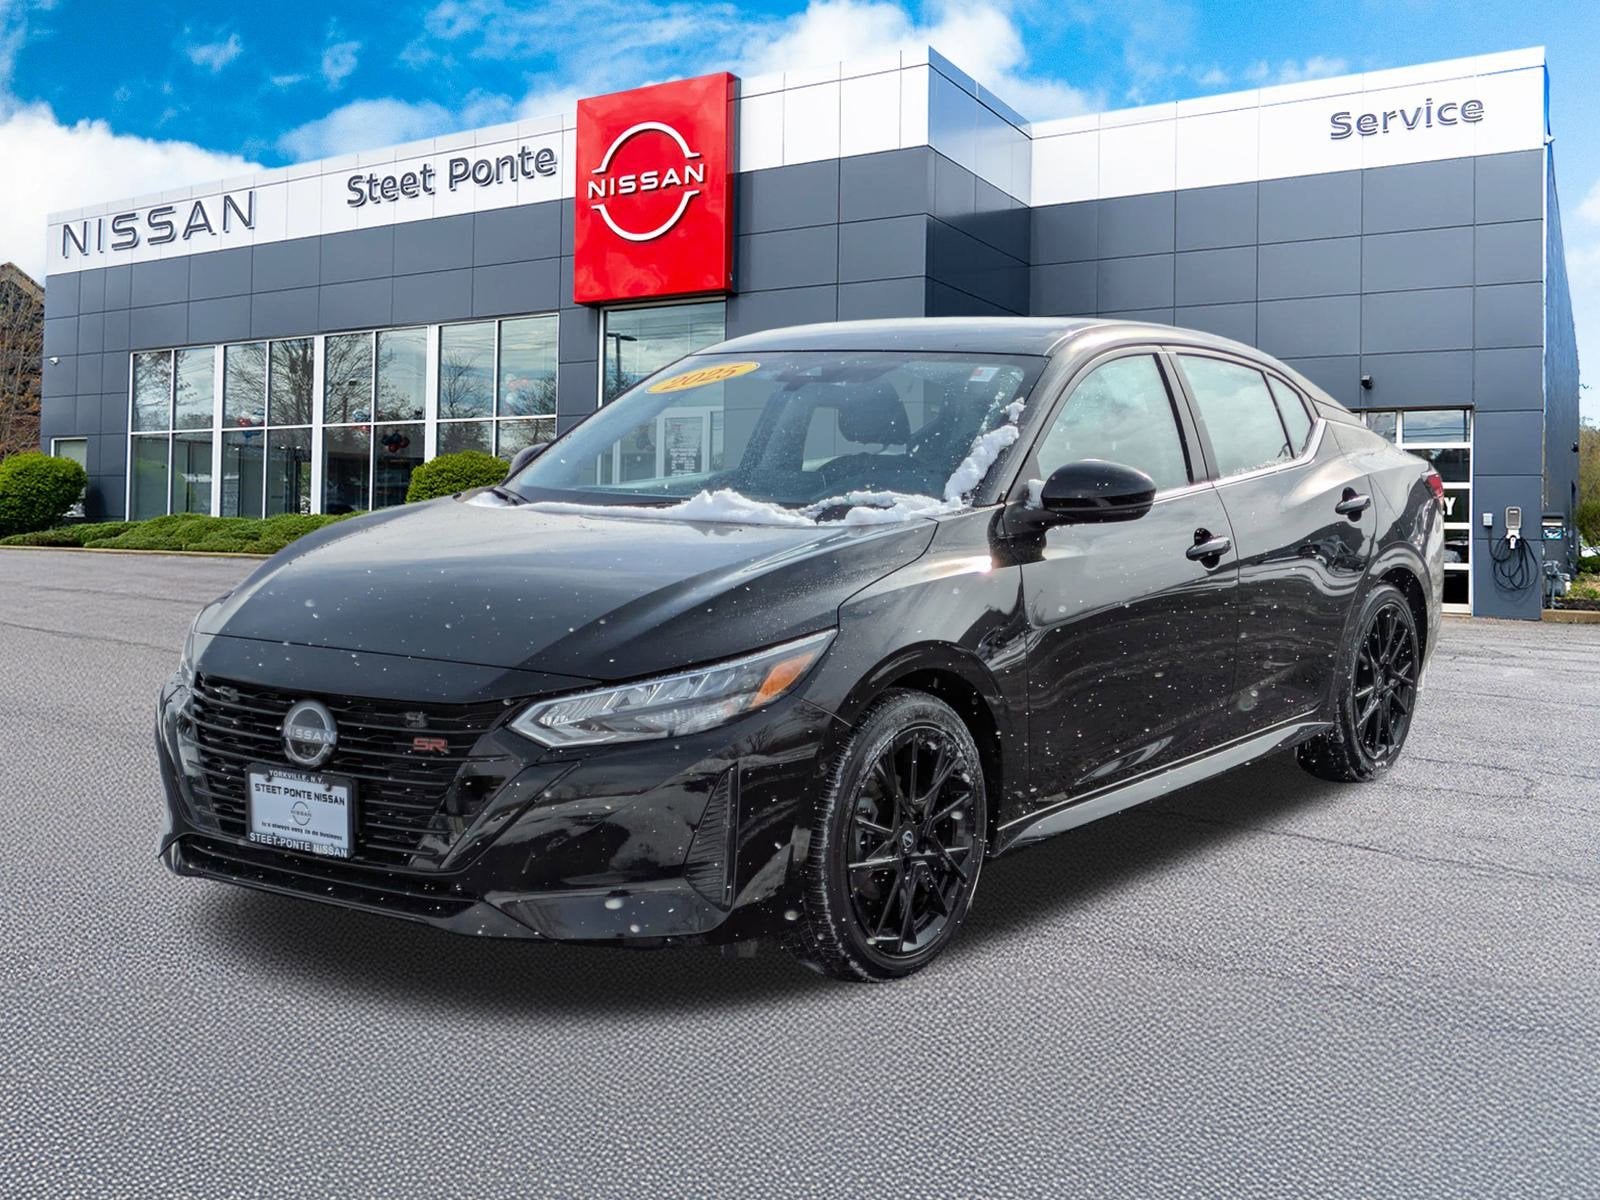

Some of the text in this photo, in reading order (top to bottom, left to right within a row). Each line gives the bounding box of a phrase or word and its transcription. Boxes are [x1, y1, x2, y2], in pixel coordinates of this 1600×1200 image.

[1330, 98, 1484, 140] Service
[347, 146, 557, 207] Steet Ponte
[587, 163, 705, 199] NISSAN
[62, 190, 255, 259] NISSAN
[660, 364, 746, 391] 2025
[283, 727, 337, 744] NISSAN
[413, 737, 449, 753] SR
[254, 783, 345, 806] STEET PONTE NISSAN
[312, 843, 348, 858] NISSAN
